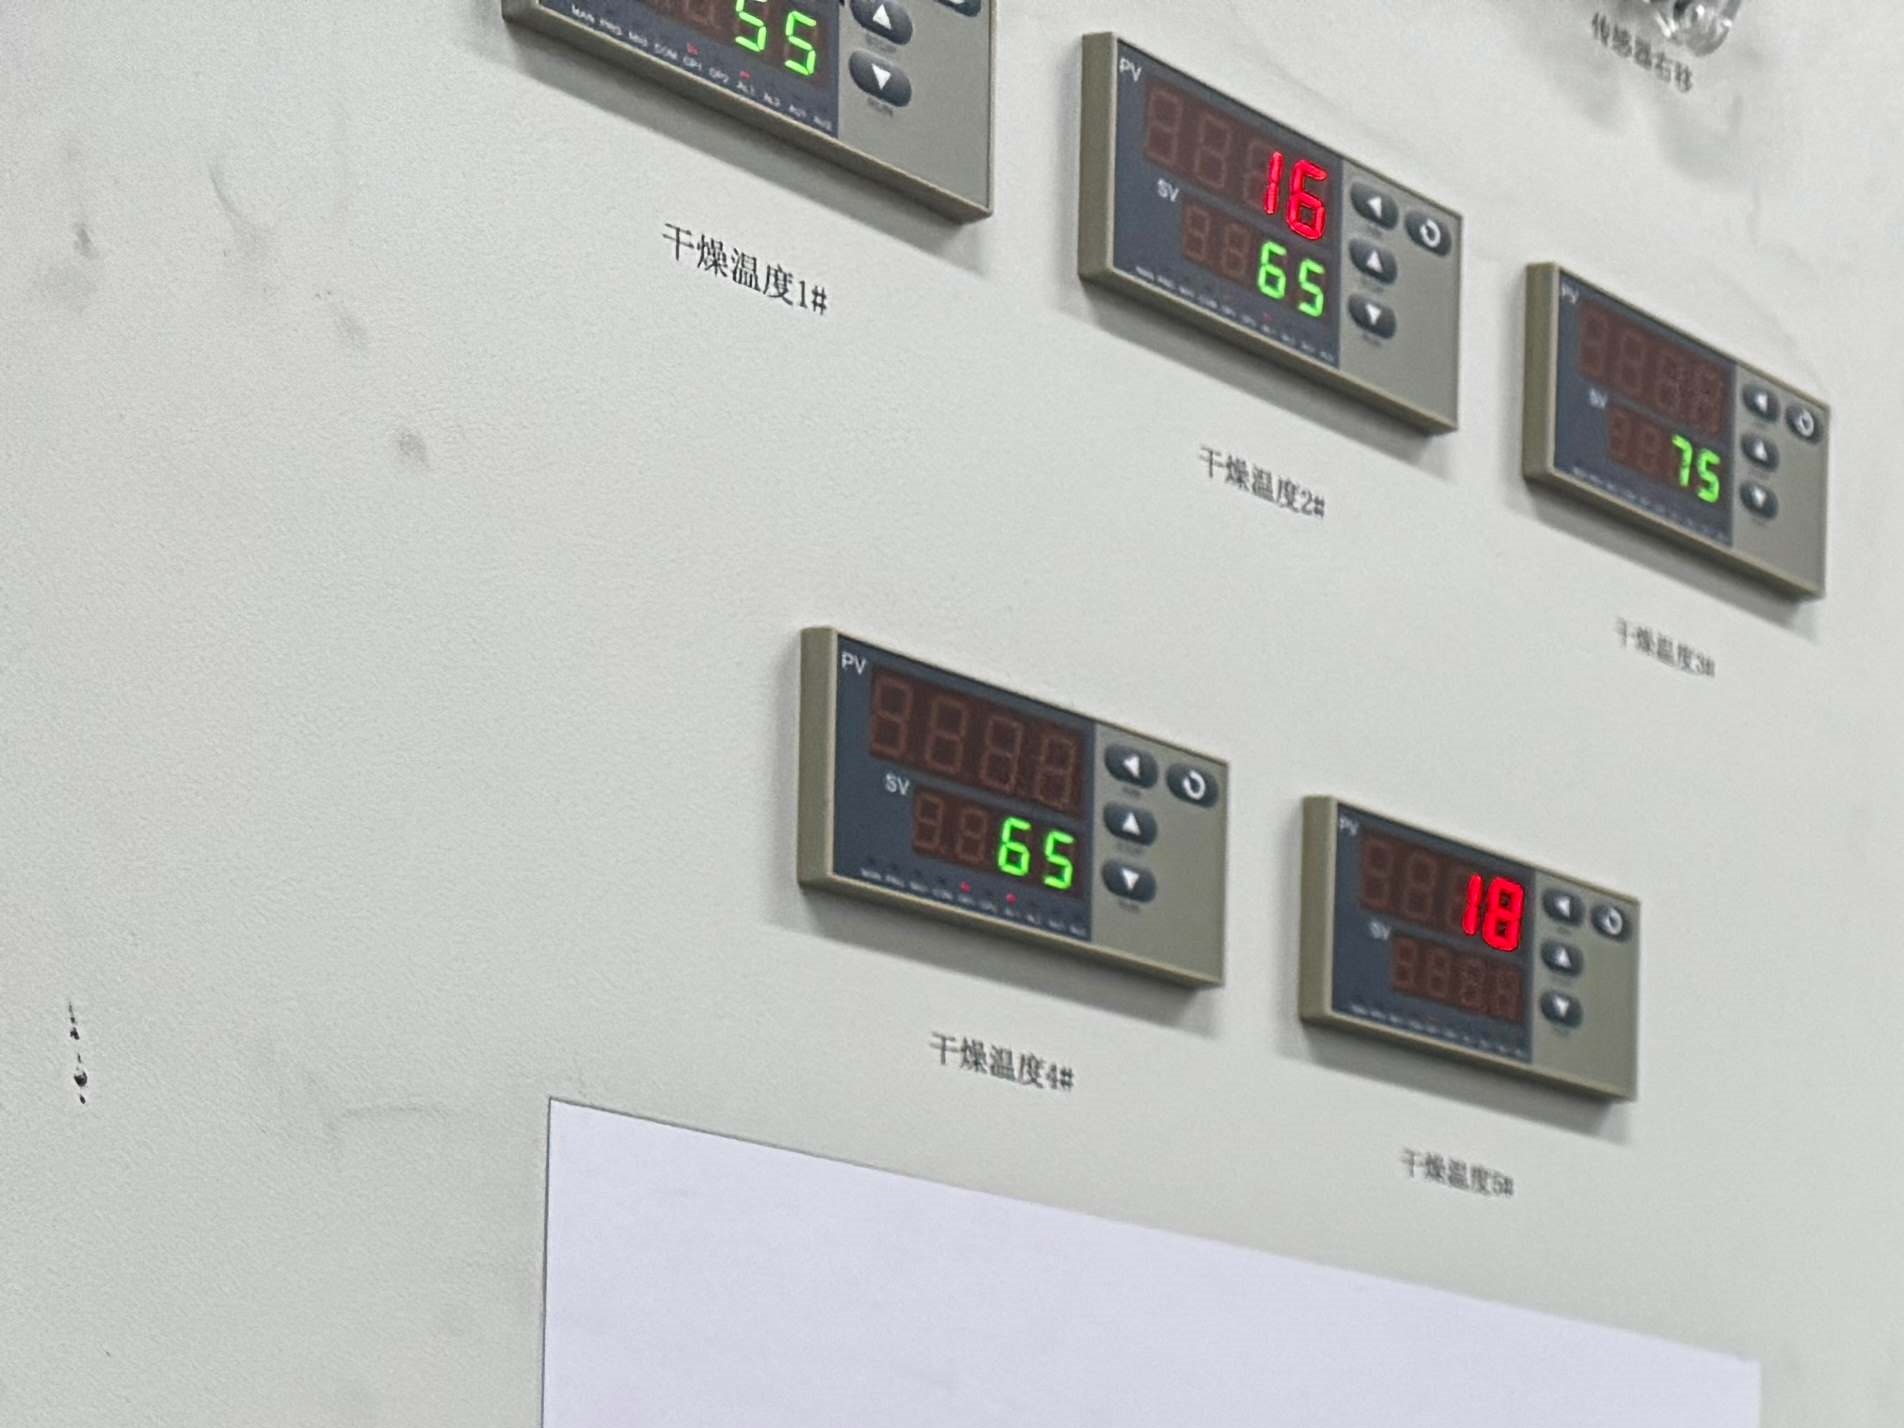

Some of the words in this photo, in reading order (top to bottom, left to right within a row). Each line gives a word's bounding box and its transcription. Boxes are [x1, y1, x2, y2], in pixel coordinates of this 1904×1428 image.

[735, 0, 817, 76] 55
[1119, 56, 1143, 82] PV
[1157, 178, 1179, 202] SV
[1263, 151, 1330, 241] 16
[662, 222, 828, 316] 干燥温度1#
[1257, 241, 1326, 317] 65
[1199, 445, 1326, 519] 干燥温度2#
[1672, 434, 1721, 503] 75
[841, 650, 866, 676] PV
[885, 773, 910, 797] SV
[997, 816, 1075, 891] 65
[1462, 874, 1525, 952] 18
[928, 1031, 1074, 1092] 干燥温度4#
